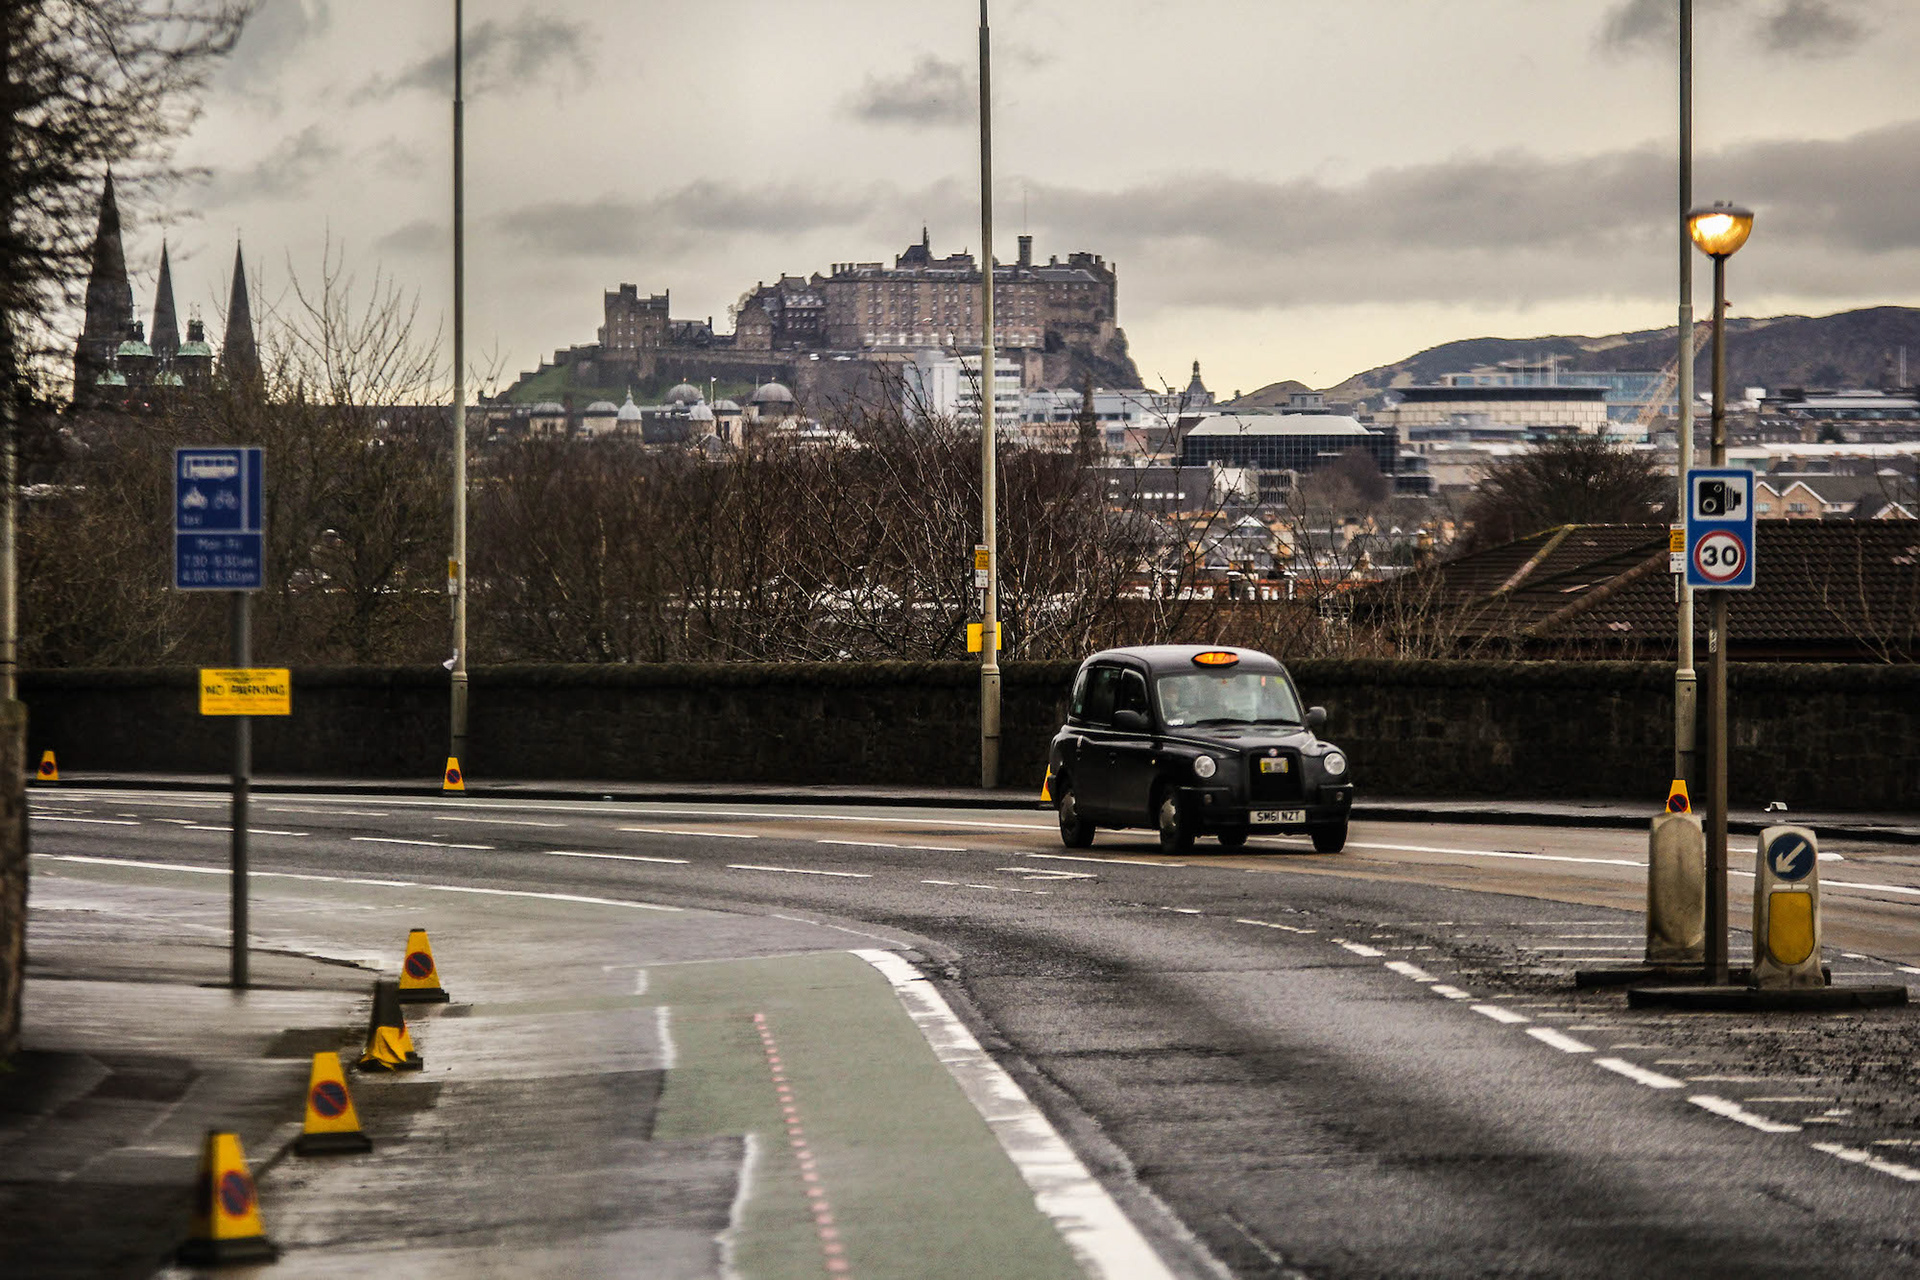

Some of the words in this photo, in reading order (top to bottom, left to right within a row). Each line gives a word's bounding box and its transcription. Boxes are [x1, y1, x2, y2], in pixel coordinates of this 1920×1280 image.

[1702, 546, 1739, 567] 30
[205, 685, 224, 696] NO
[230, 685, 285, 697] PARKING
[1257, 811, 1279, 822] SM61
[1282, 811, 1300, 822] NZT
